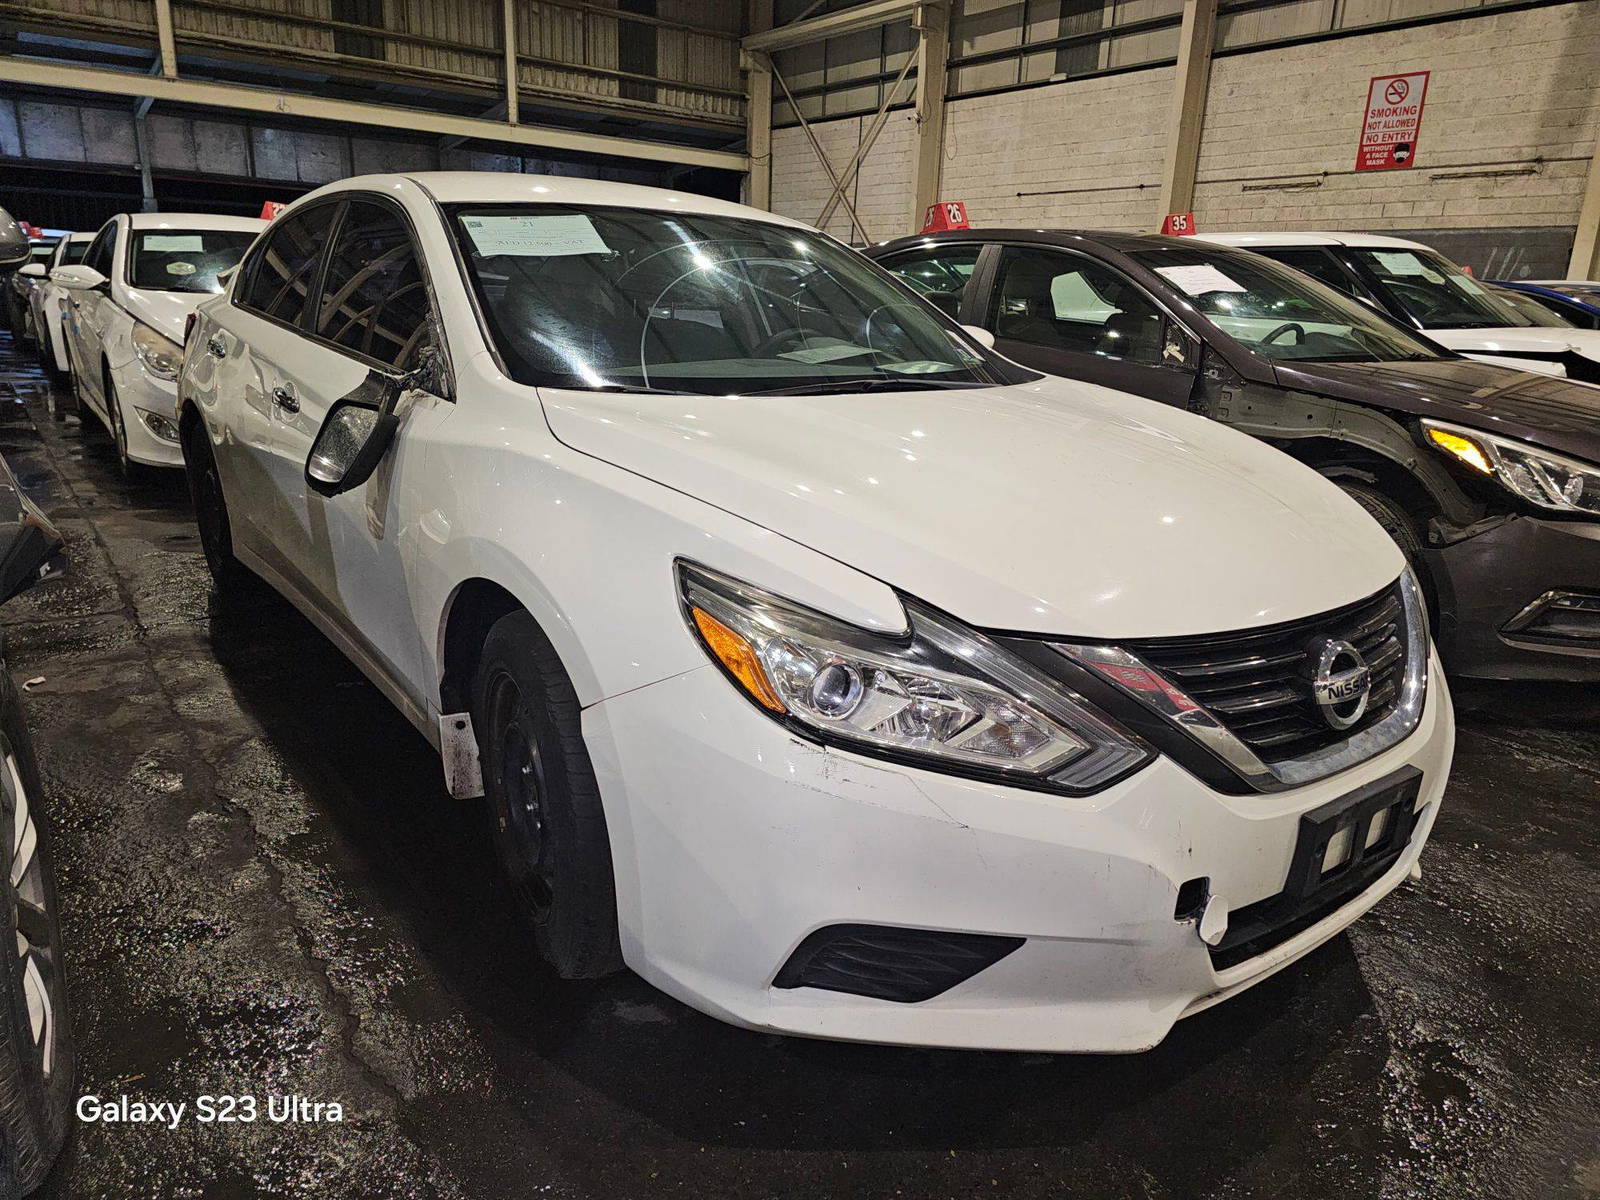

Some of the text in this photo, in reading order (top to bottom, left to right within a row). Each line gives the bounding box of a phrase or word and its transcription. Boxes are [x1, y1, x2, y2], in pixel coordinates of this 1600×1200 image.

[1370, 105, 1417, 119] SMOKING
[1367, 118, 1416, 131] NOT ALLOWED
[1366, 131, 1413, 143] NO ENTRY
[1363, 144, 1393, 152] WITHOUT
[947, 204, 962, 223] 26
[1173, 215, 1187, 231] 35
[1328, 677, 1367, 699] NISSA
